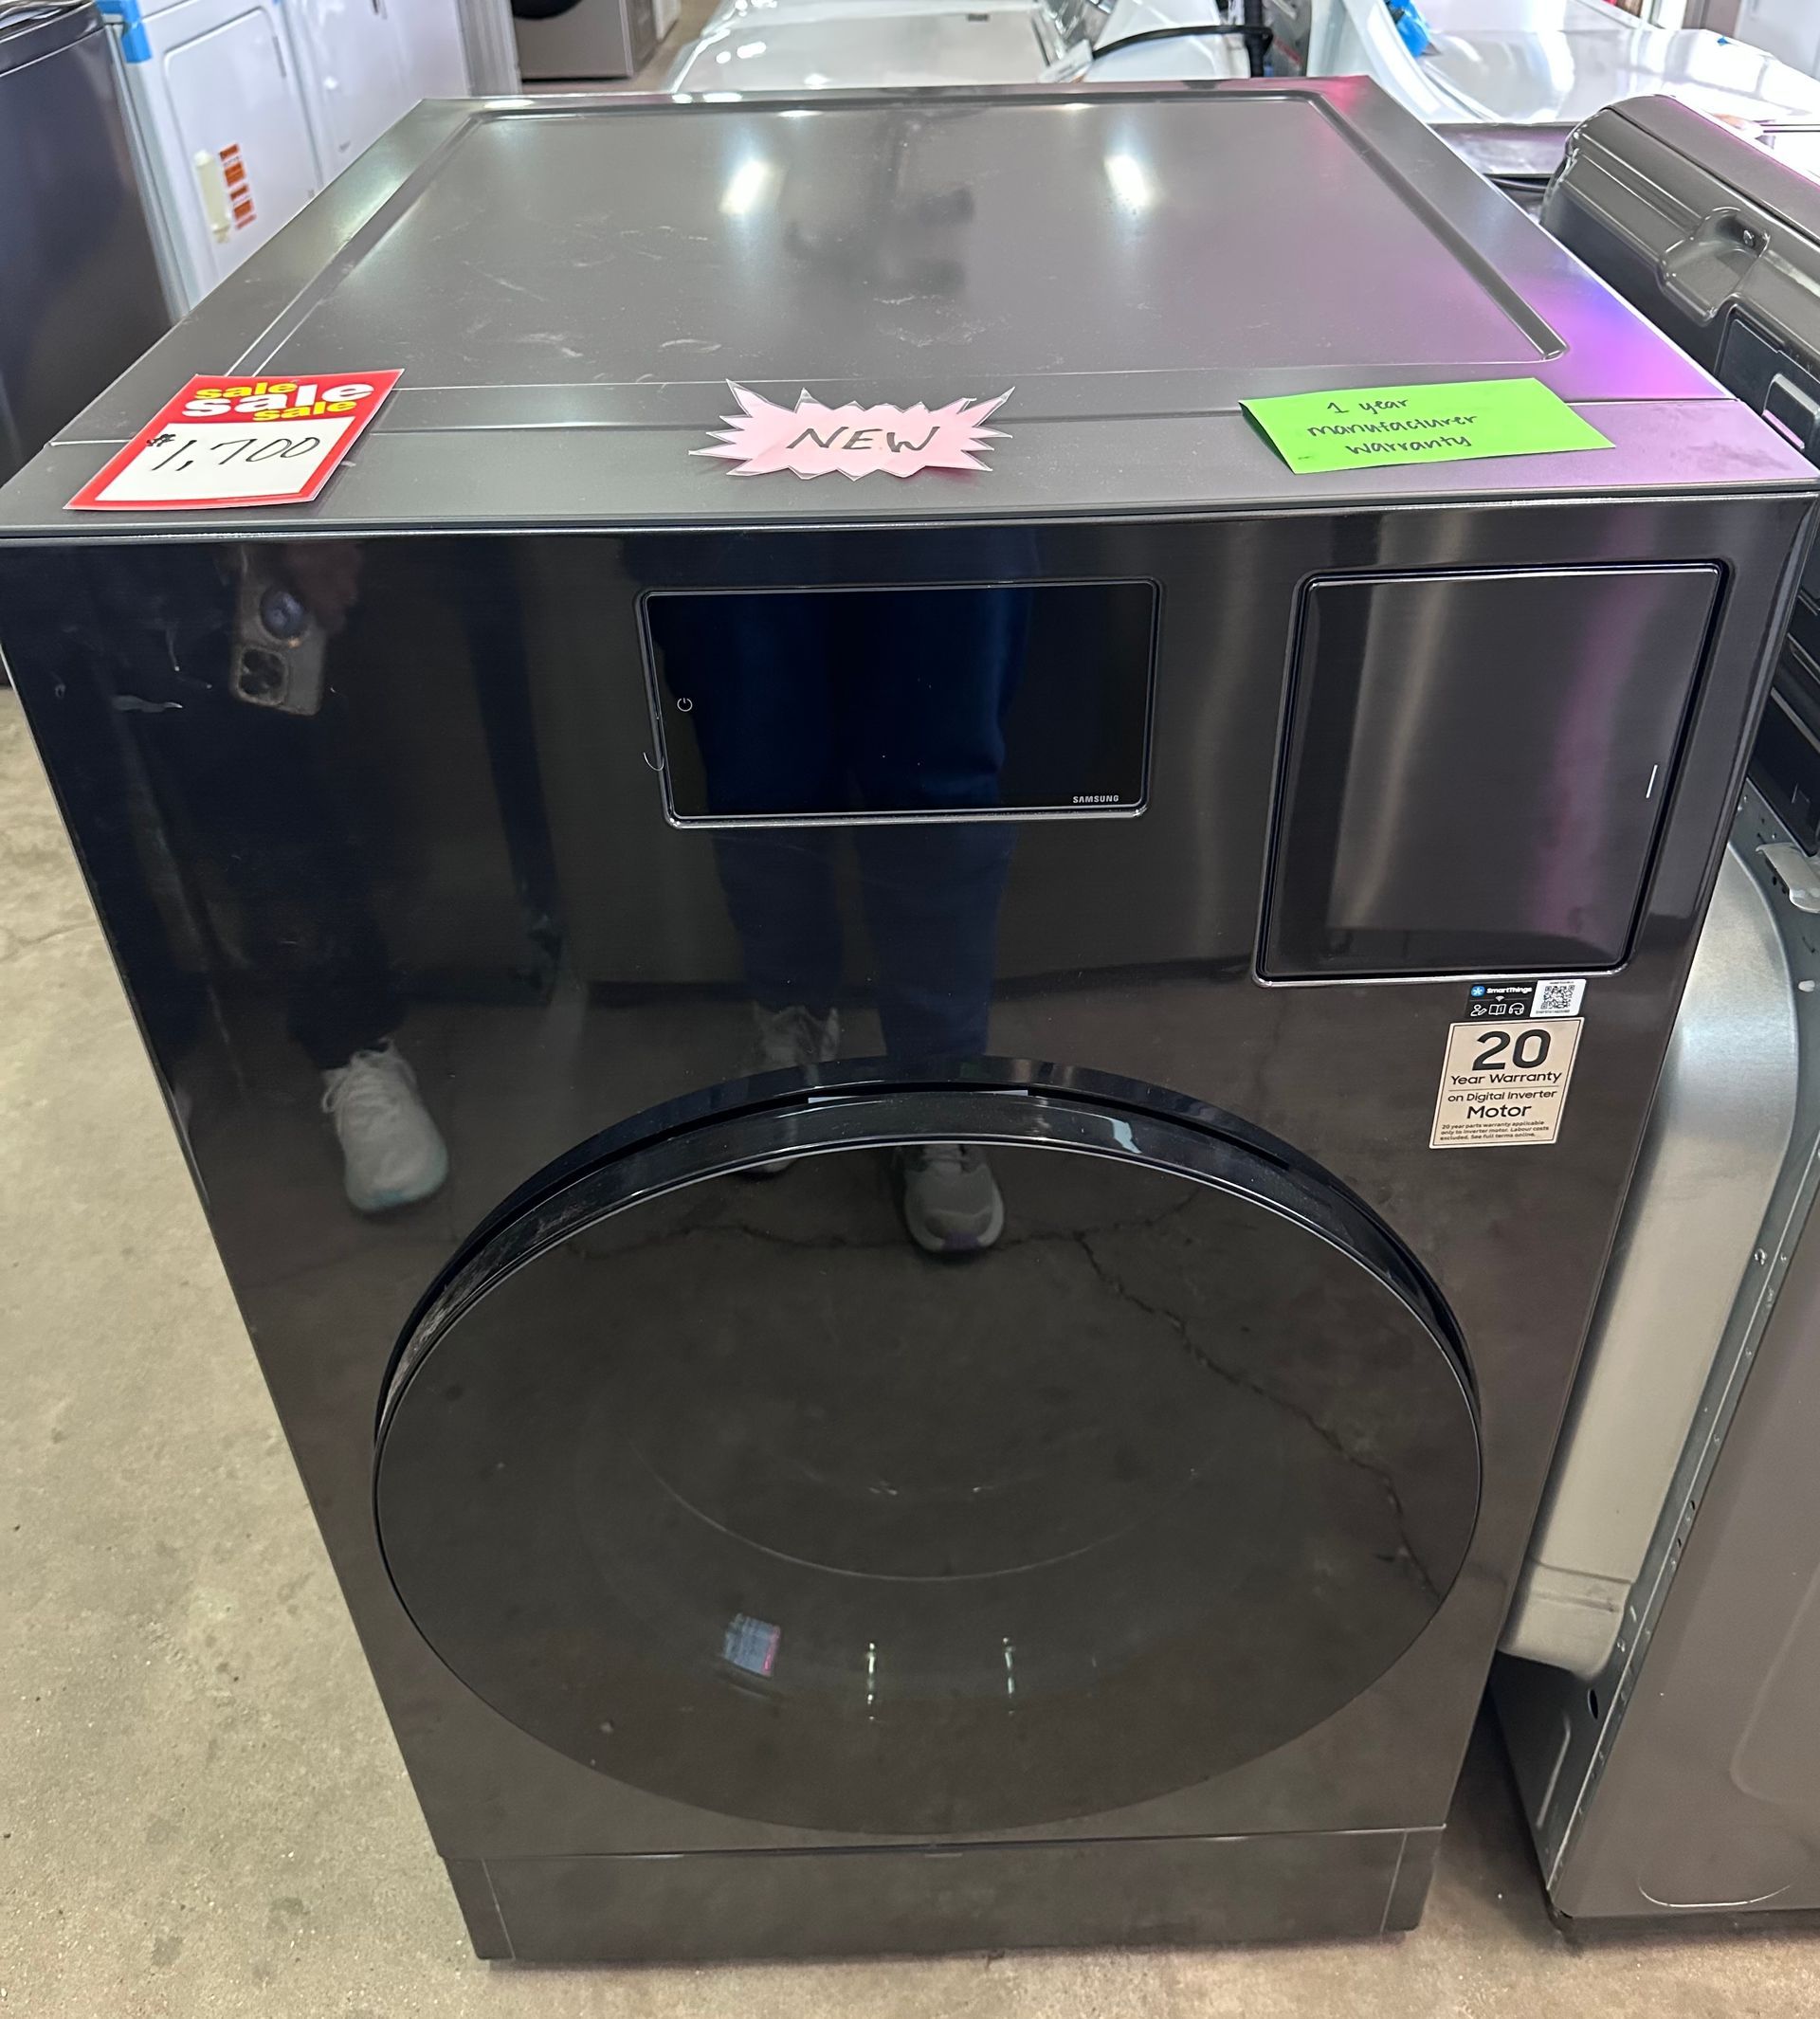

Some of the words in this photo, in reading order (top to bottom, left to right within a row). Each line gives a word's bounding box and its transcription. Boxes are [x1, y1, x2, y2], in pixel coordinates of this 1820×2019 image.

[194, 382, 298, 399] sale
[182, 384, 374, 417] sale
[1327, 402, 1349, 414] 1
[1358, 398, 1409, 414] year
[252, 401, 356, 421] sale
[1307, 415, 1478, 437] manufacturer
[786, 426, 941, 452] NEW
[1345, 434, 1472, 455] warranty
[1072, 794, 1119, 804] SAMSUNG
[1472, 1028, 1551, 1071] 20
[1450, 1075, 1486, 1085] Year
[1489, 1071, 1562, 1084] Warranty
[1447, 1094, 1465, 1102] on
[1466, 1091, 1505, 1103] Digital
[1507, 1090, 1557, 1100] Inverter
[1466, 1104, 1533, 1119] Motor
